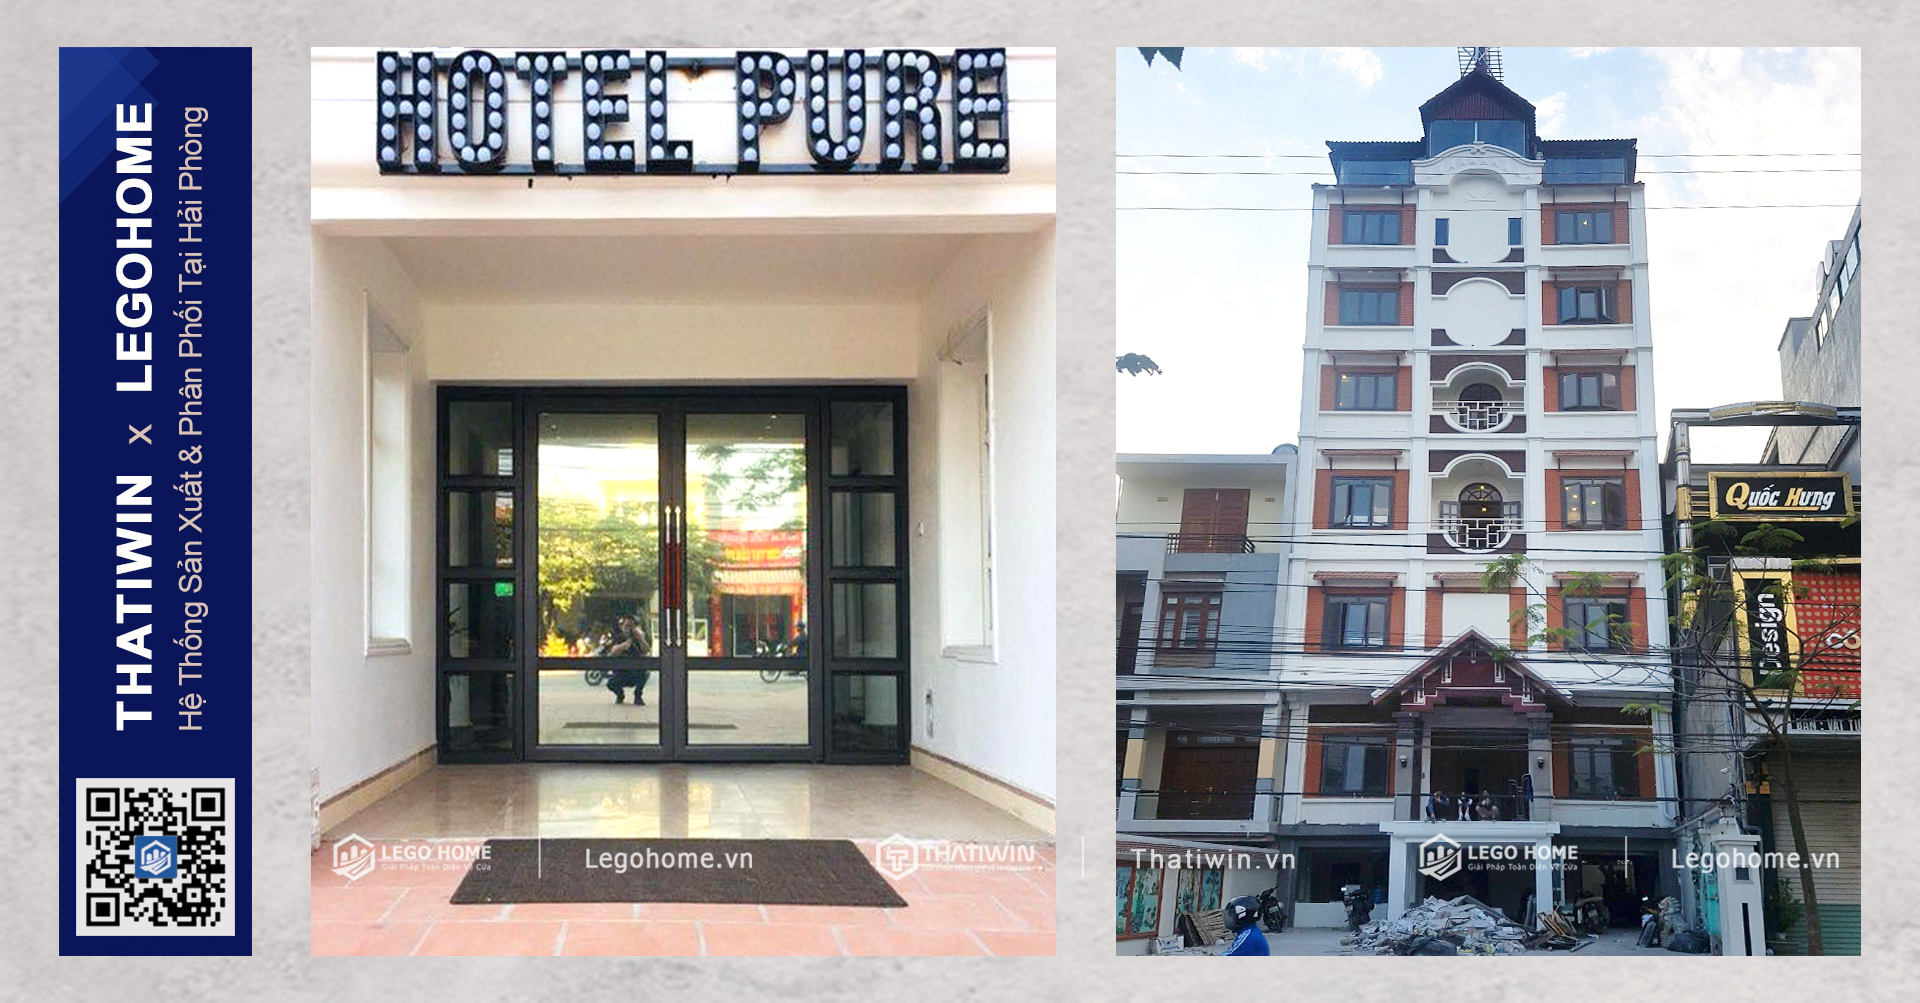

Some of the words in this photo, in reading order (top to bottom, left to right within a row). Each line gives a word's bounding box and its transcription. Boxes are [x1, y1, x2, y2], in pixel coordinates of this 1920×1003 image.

[377, 48, 694, 173] HOTEL
[736, 47, 1009, 172] PURE
[1725, 482, 1781, 511] Quốc
[1785, 487, 1836, 511] Hưng
[1754, 593, 1783, 675] Design
